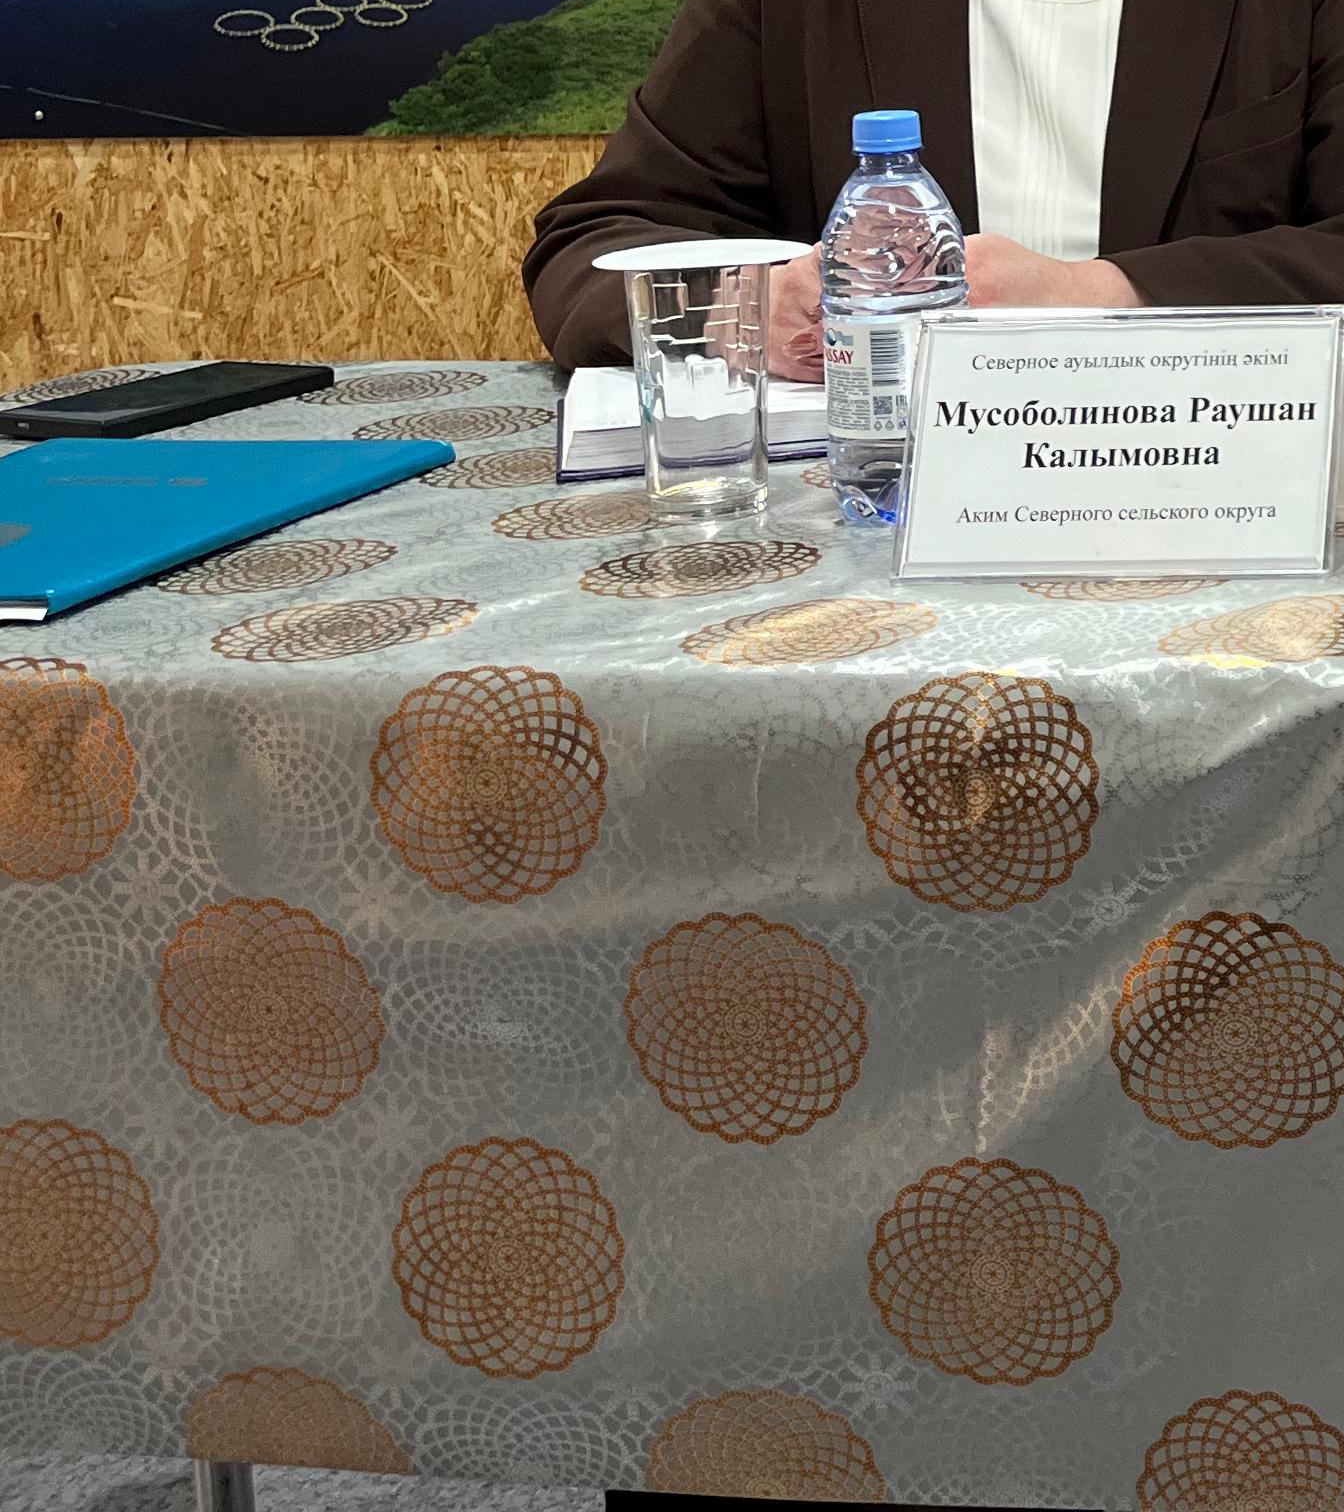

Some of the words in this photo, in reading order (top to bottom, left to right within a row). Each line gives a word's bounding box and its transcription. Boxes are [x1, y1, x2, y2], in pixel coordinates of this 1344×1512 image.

[972, 353, 1060, 375] Северное
[1064, 353, 1146, 373] ауылдық
[1149, 349, 1239, 373] округінің
[1243, 348, 1289, 368] әкімі
[933, 398, 1177, 434] Мусоболинова
[1189, 395, 1318, 431] Раушан
[1021, 441, 1221, 470] Калымовна
[956, 506, 1009, 525] Аким
[1013, 505, 1114, 525] Северного
[1117, 503, 1209, 523] сельского
[1214, 504, 1277, 524] округа
